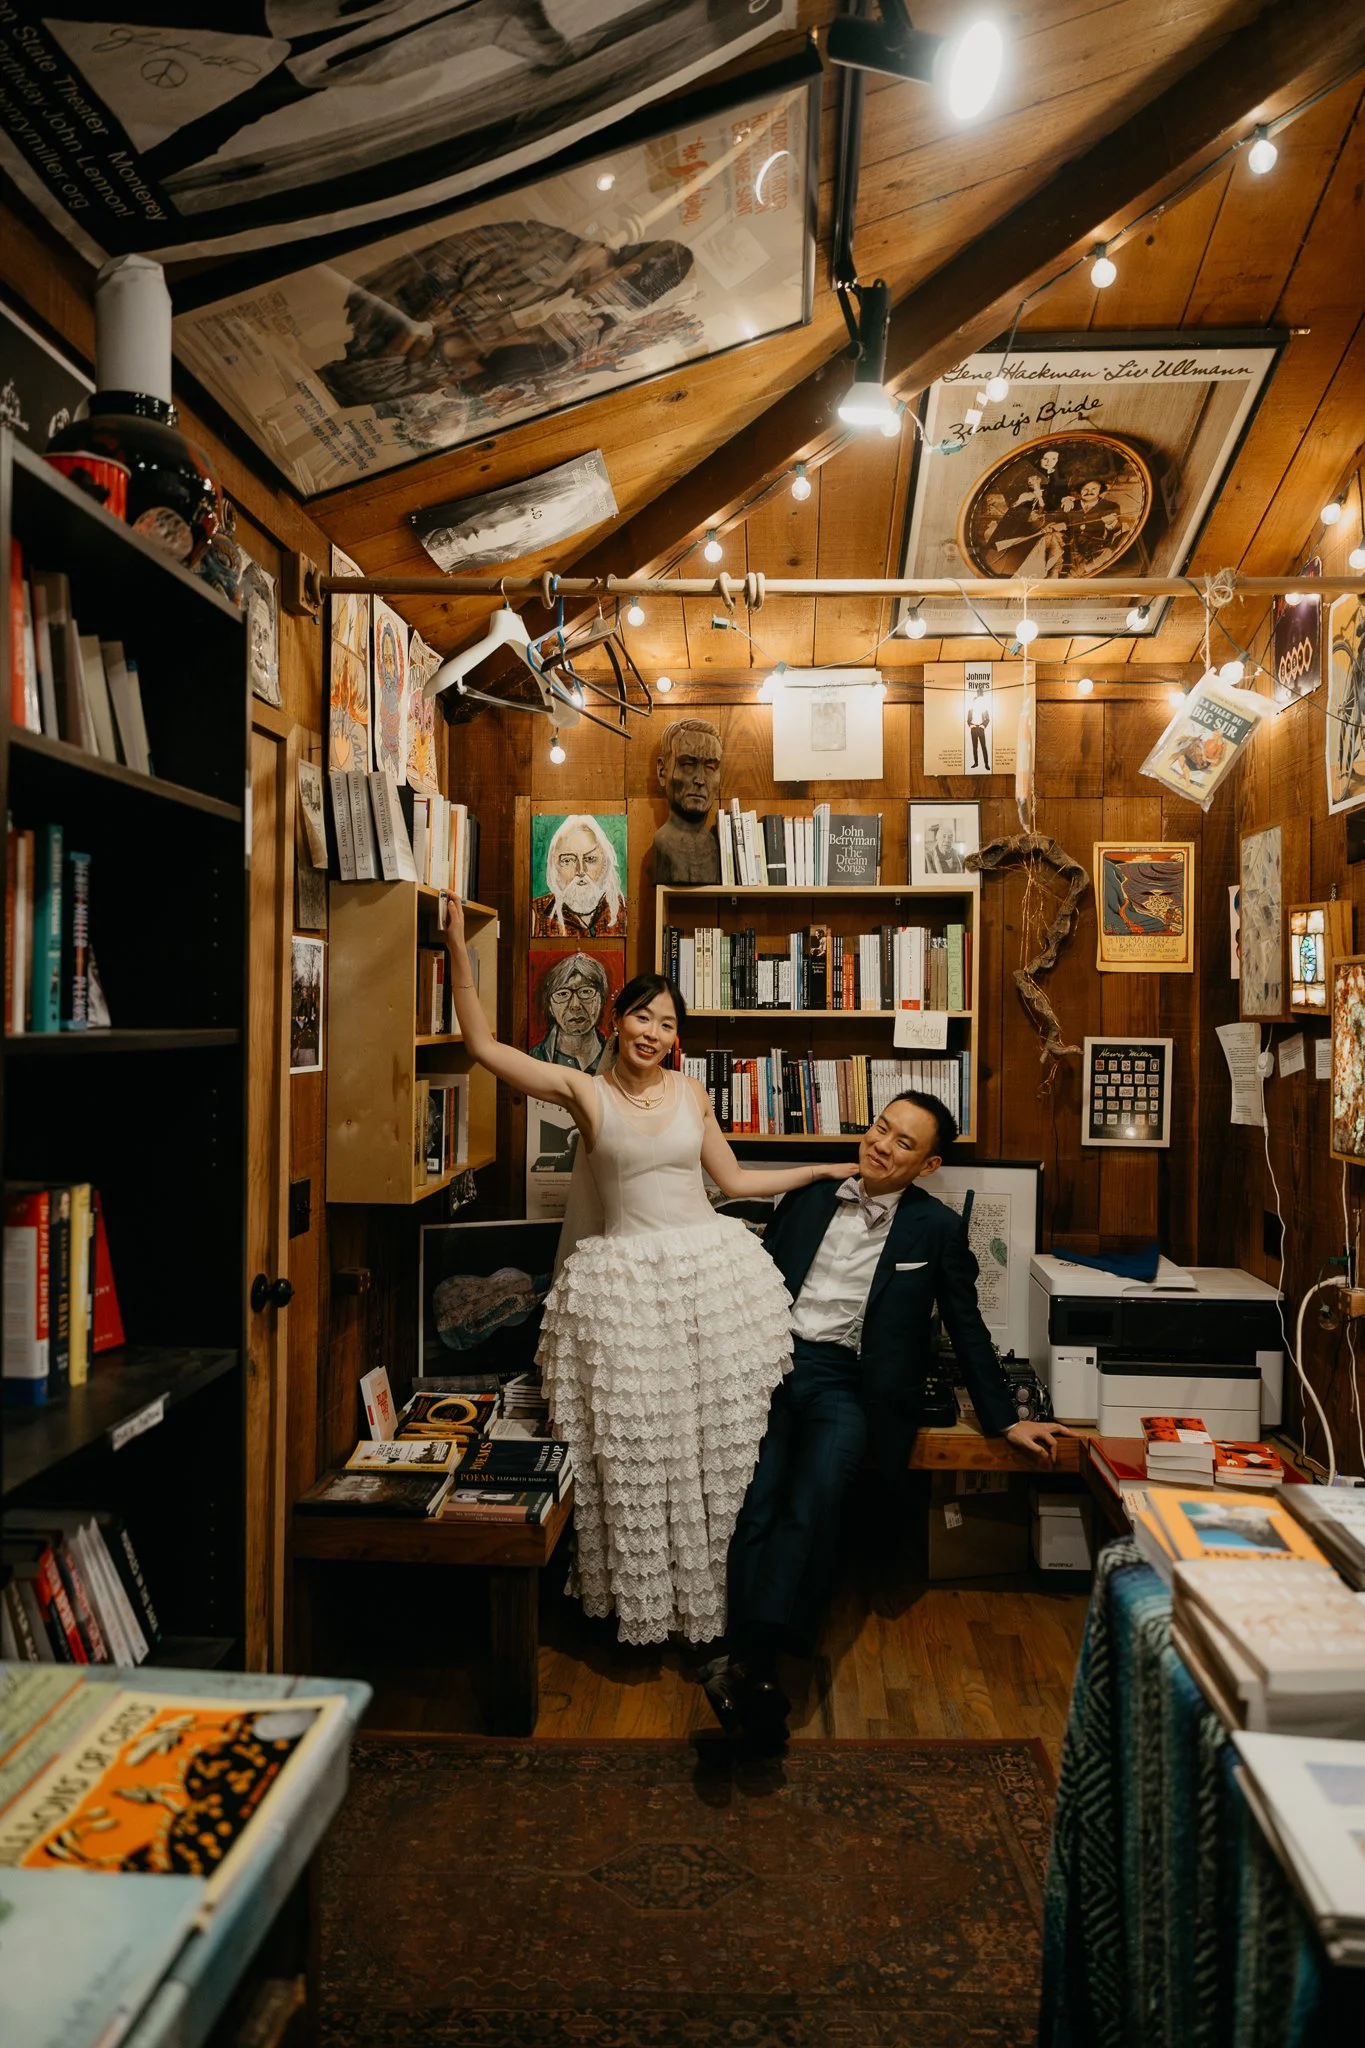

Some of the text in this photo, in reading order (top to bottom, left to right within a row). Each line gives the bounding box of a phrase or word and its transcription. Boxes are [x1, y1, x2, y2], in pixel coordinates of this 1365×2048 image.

[12, 25, 167, 220] State Theater Monterey
[42, 107, 82, 152] John
[76, 154, 135, 218] Lennon!
[1001, 361, 1100, 381] Hackman
[1103, 360, 1149, 381] Liv
[1152, 359, 1255, 378] Ullmann
[1035, 395, 1104, 423] Bride
[966, 672, 991, 681] Johnny
[968, 681, 990, 690] Rivers
[1192, 704, 1214, 726] BIG
[1211, 716, 1238, 740] SUR
[1199, 697, 1212, 712] LA
[1209, 701, 1234, 723] FILLE
[1230, 713, 1244, 727] DU
[338, 809, 348, 847] TESTAMENT
[356, 808, 364, 847] TESTAMENT
[379, 809, 390, 847] TESTAMENT
[830, 832, 876, 848] Berryman
[839, 825, 864, 838] John
[836, 854, 868, 868] Dream
[842, 846, 863, 859] The
[838, 862, 866, 876] Songs
[671, 931, 679, 959] POEMS
[1099, 1048, 1154, 1060] Henry Miller
[721, 1088, 729, 1120] RIMBAUD
[469, 1442, 492, 1471] POEMS
[460, 1473, 495, 1482] POEMS
